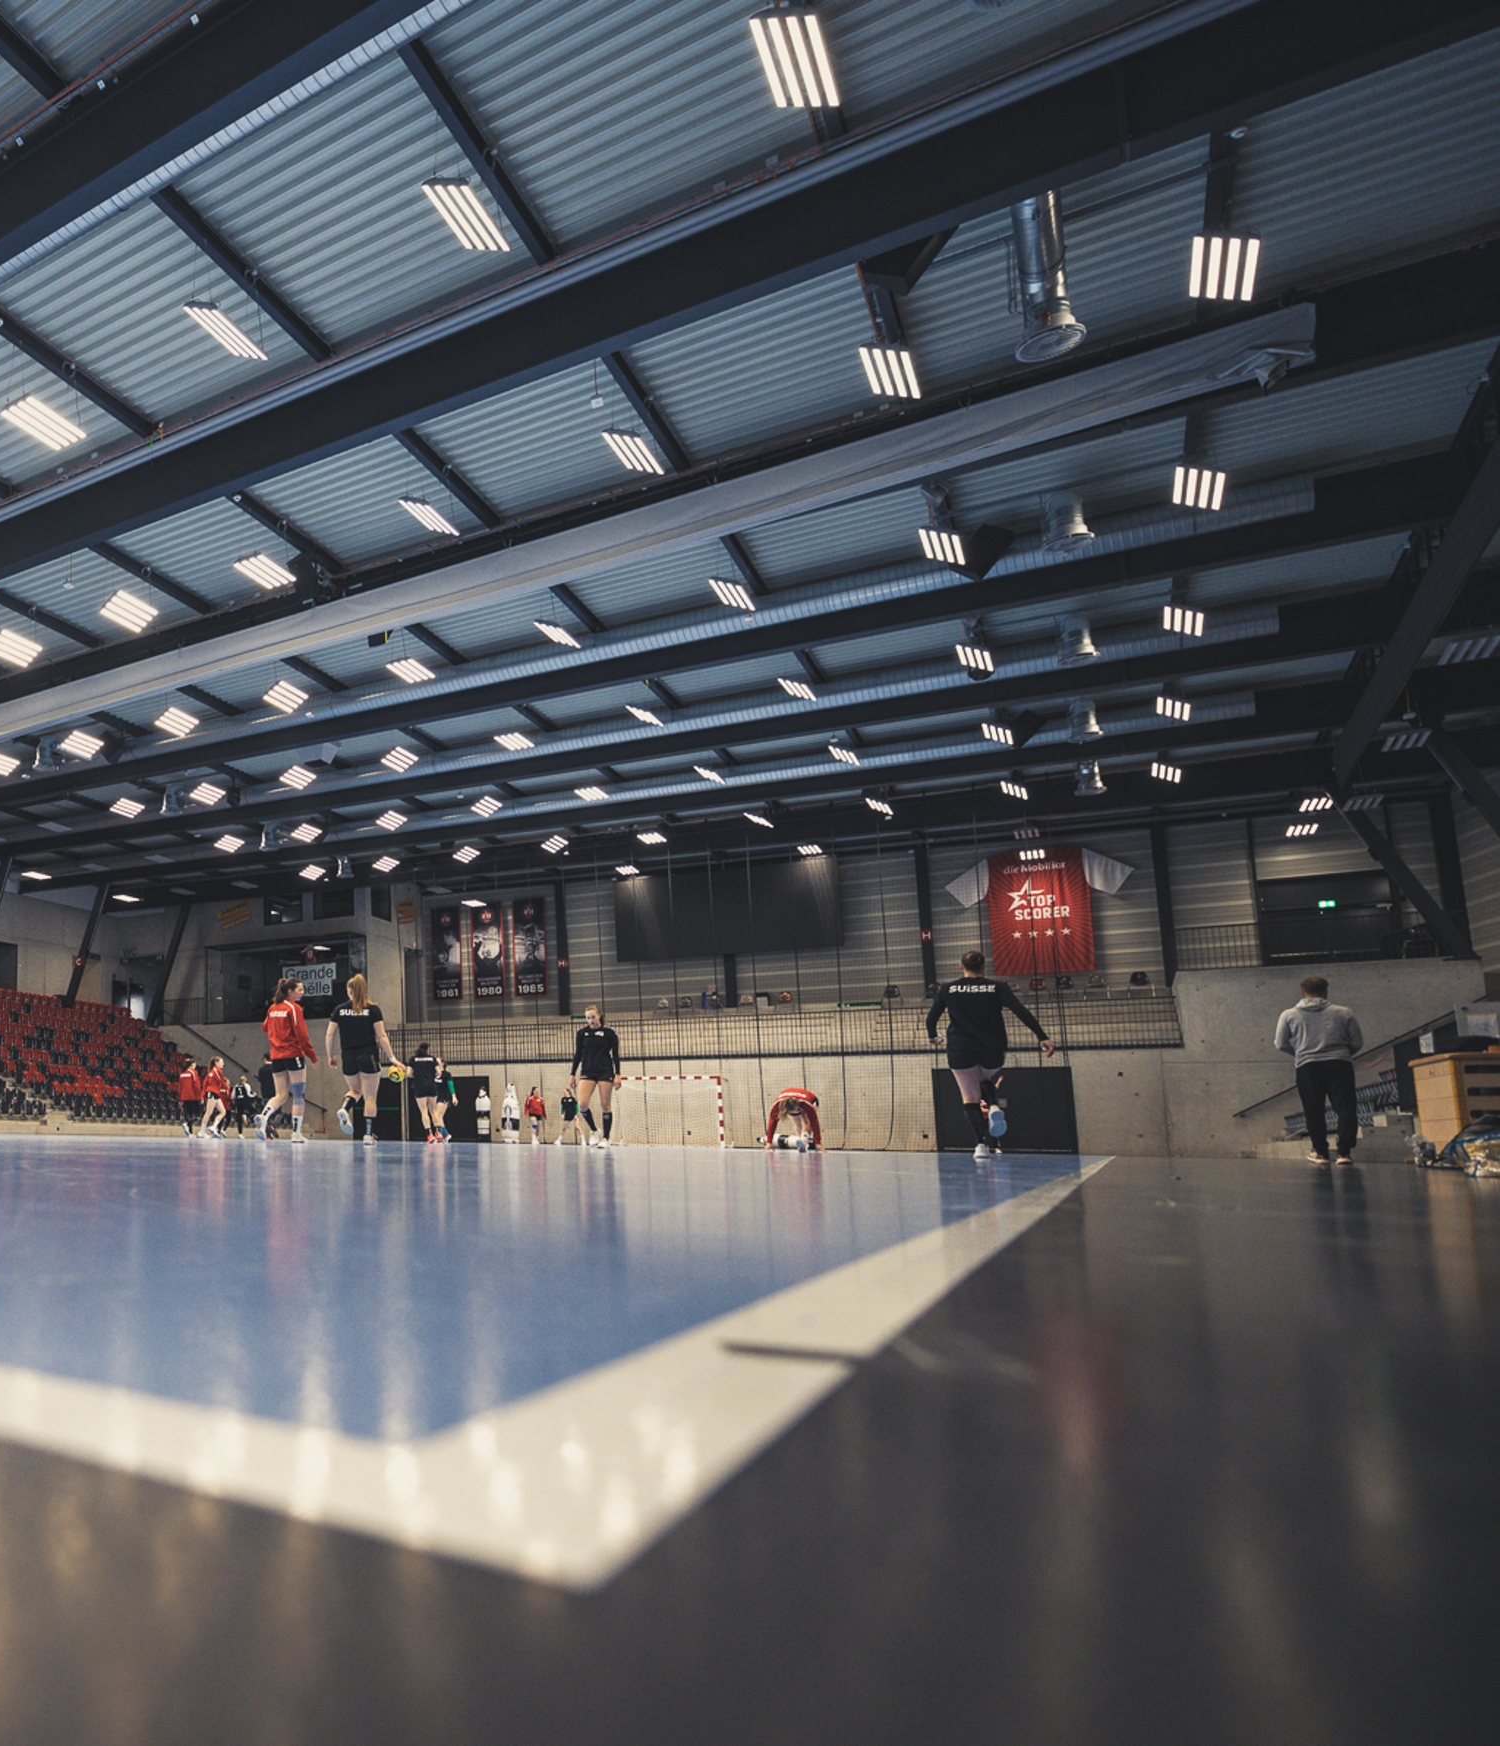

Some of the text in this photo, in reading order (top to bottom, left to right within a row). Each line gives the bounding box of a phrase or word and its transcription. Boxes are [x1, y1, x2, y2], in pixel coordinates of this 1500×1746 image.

[1003, 861, 1067, 875] die Mobiliar
[1028, 894, 1056, 907] TOP
[1014, 905, 1071, 921] SCORER
[285, 966, 334, 981] Grande
[302, 981, 331, 996] oëlle
[948, 984, 996, 994] SUISSE
